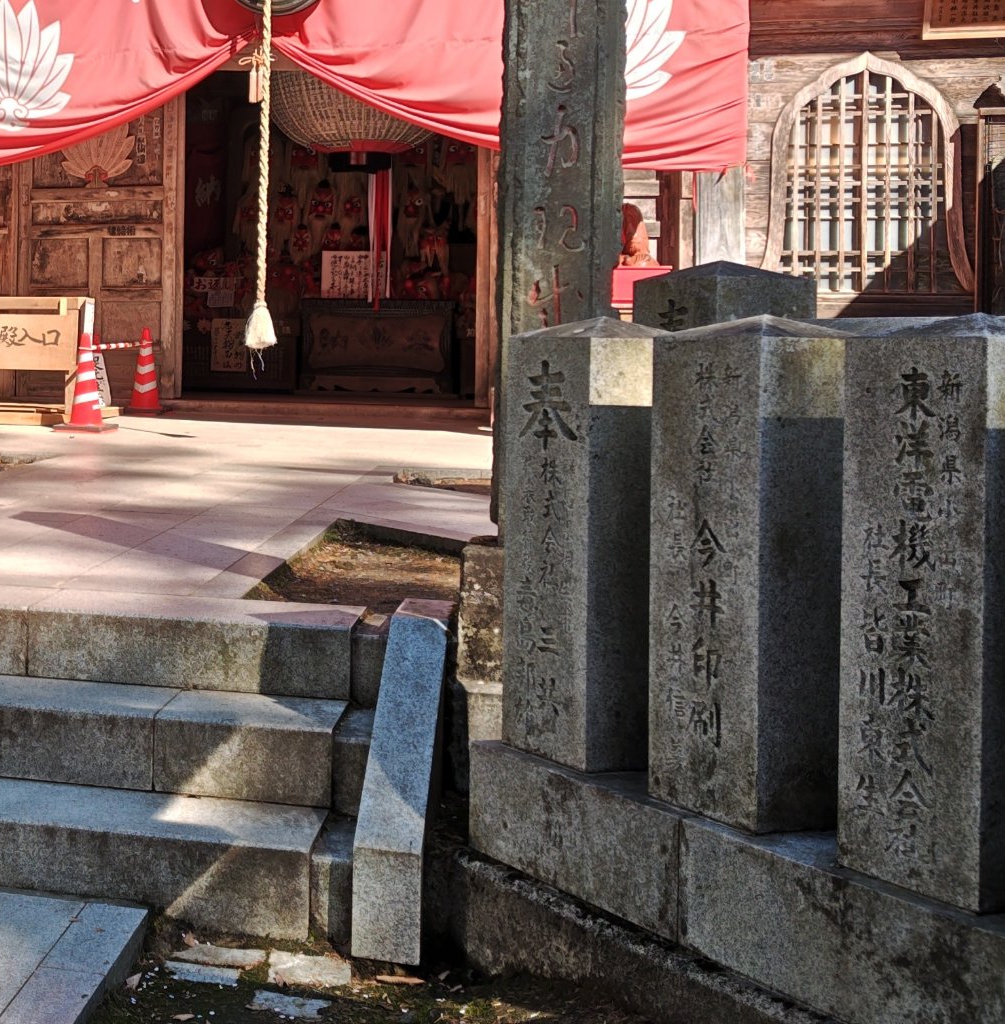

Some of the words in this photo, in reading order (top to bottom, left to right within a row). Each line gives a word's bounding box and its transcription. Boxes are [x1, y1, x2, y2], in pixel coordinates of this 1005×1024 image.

[519, 359, 579, 451] 奉
[886, 366, 936, 860] 東洋電機工業株式会社
